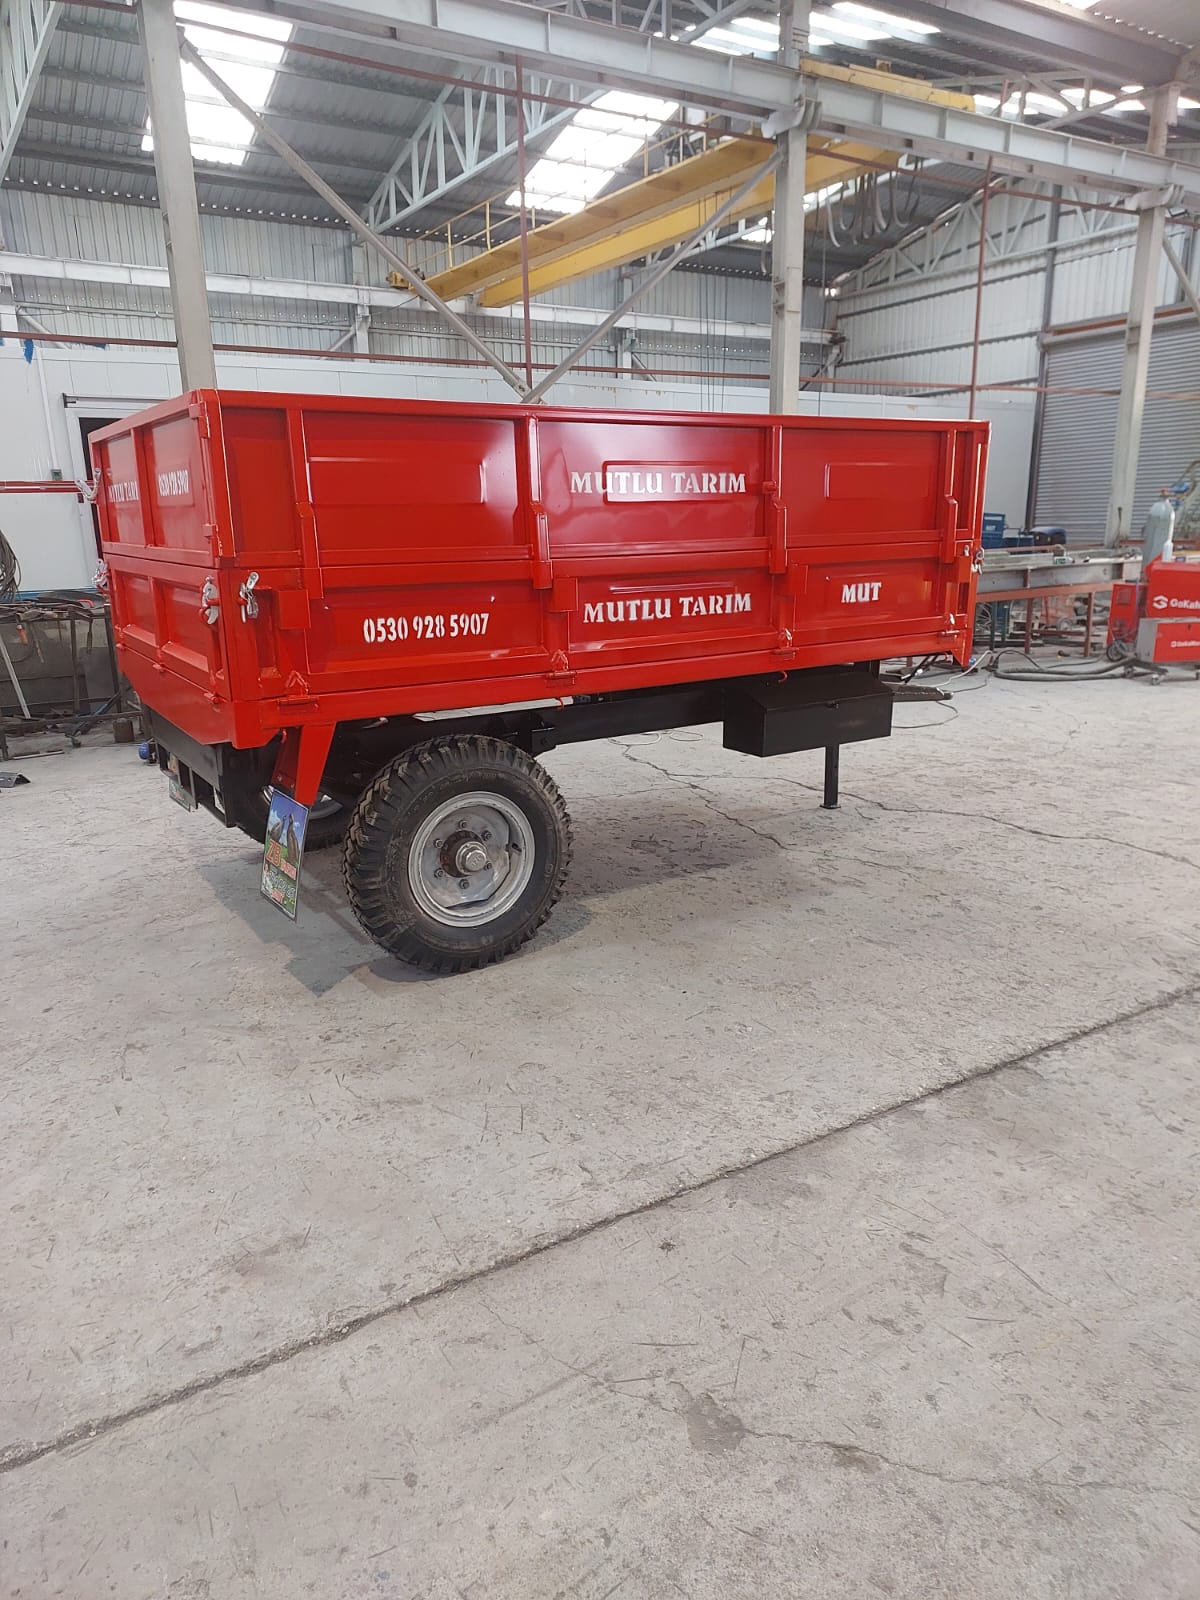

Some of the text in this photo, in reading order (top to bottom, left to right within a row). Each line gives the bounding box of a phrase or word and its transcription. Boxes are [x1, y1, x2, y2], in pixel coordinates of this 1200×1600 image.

[570, 471, 747, 494] MUTLU TARIM
[841, 582, 882, 604] MUT
[583, 593, 752, 624] MUTLU TARIM
[363, 613, 490, 643] 0530 928 5907
